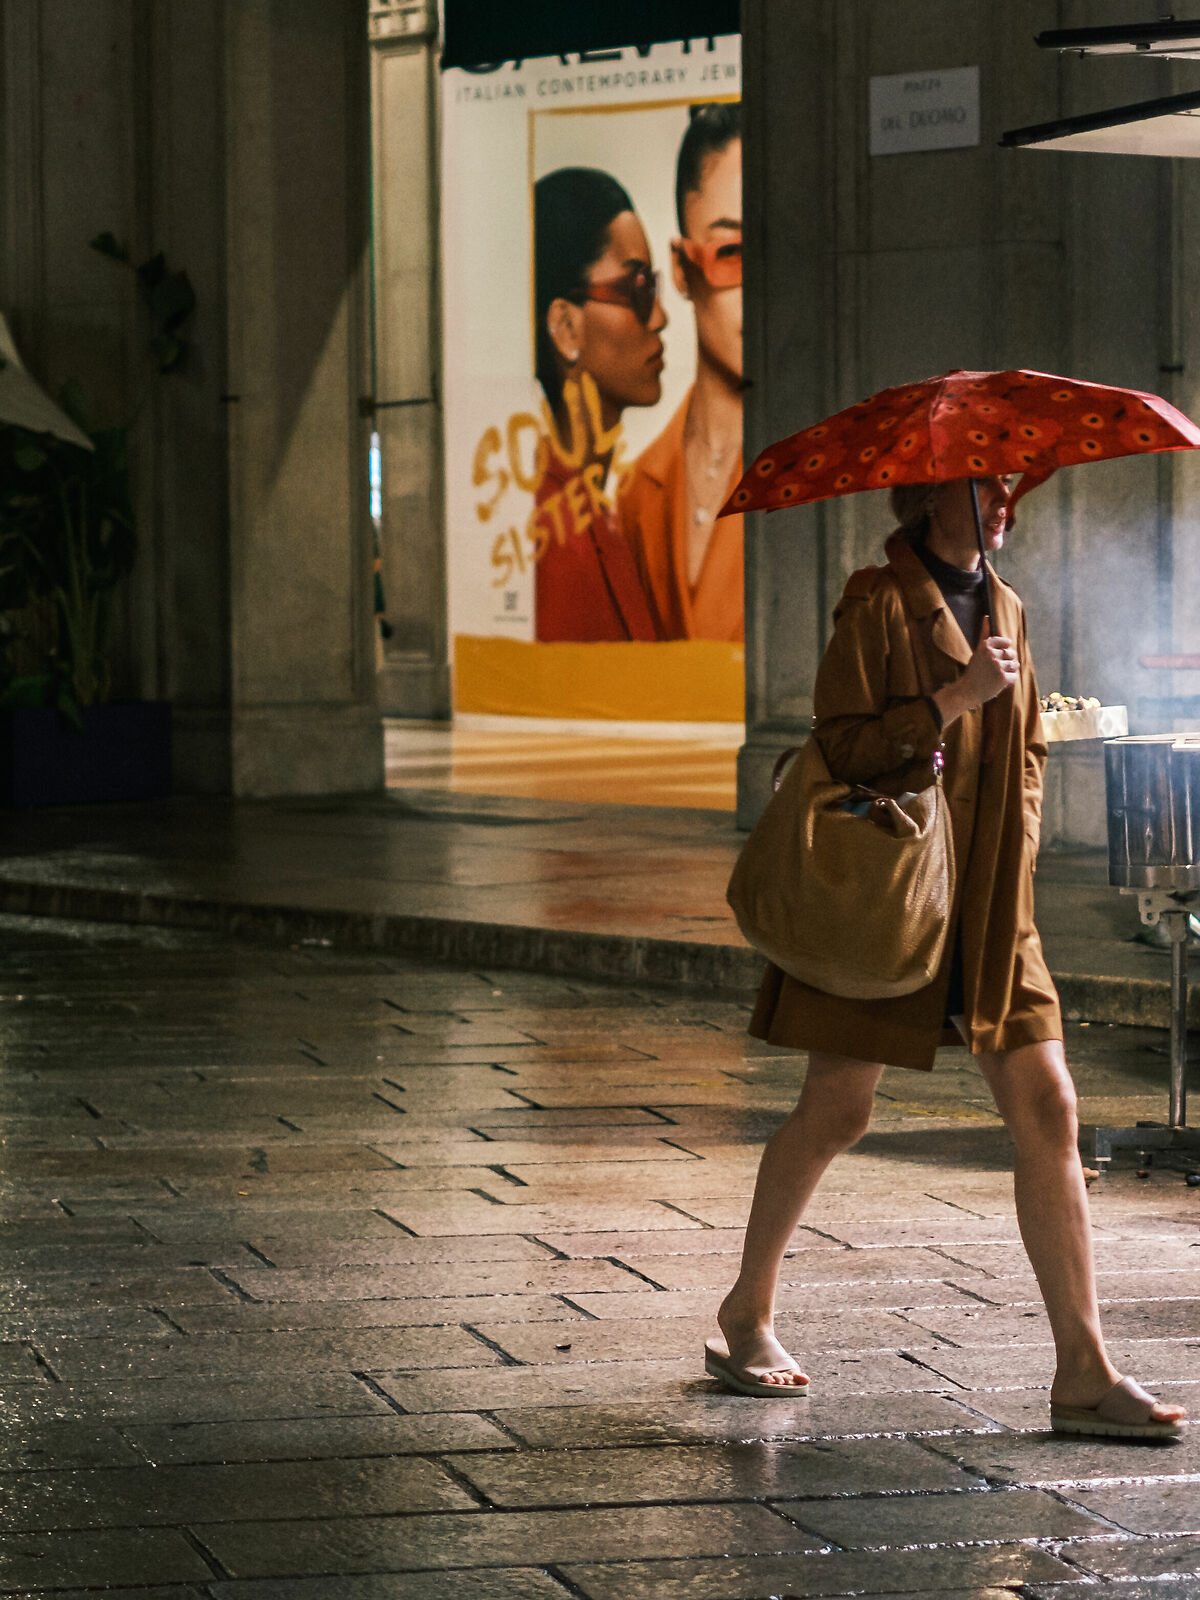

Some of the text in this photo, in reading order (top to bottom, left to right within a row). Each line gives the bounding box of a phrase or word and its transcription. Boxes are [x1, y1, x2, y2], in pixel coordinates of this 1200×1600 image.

[456, 81, 526, 102] ITALIAN
[536, 66, 687, 97] CONTEMPORARY
[472, 371, 622, 524] SOUL
